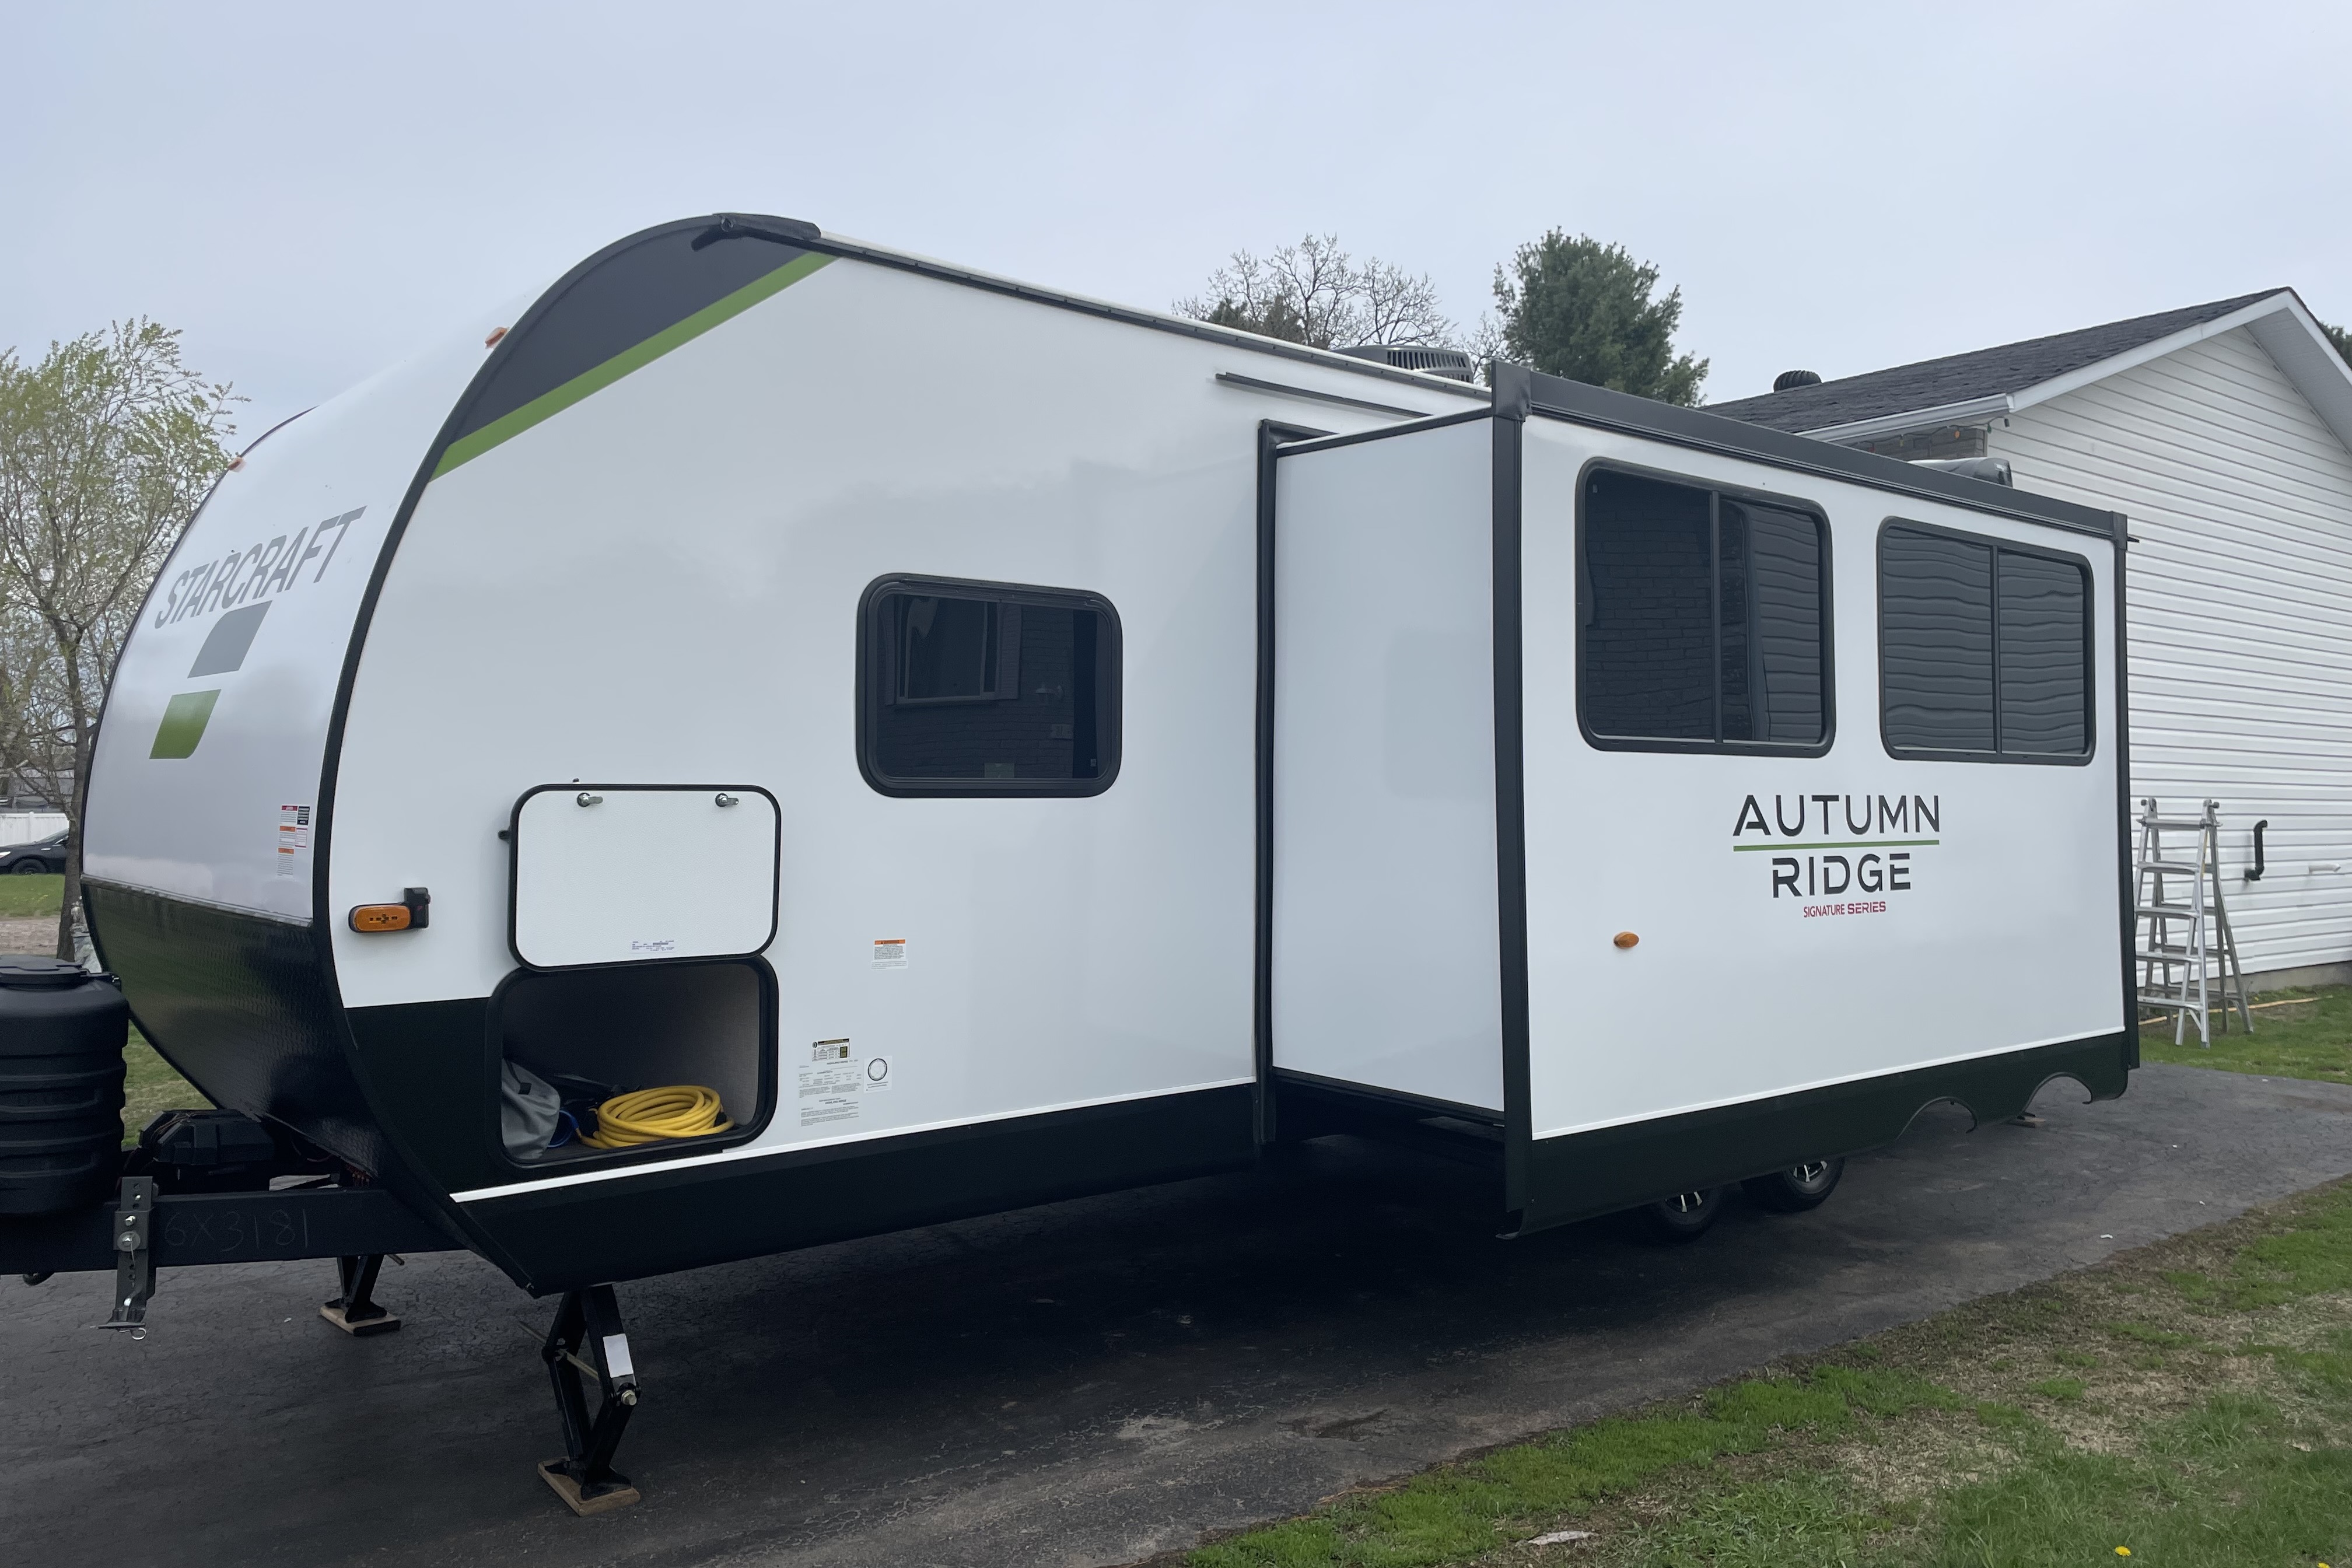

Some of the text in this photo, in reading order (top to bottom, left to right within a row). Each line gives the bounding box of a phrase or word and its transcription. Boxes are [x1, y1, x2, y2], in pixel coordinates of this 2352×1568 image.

[154, 505, 367, 629] STARCRAFT
[1732, 794, 1940, 836] AUTUMN
[1772, 853, 1911, 898] RIDGE
[1803, 901, 1887, 918] SIGNATURE SERIES
